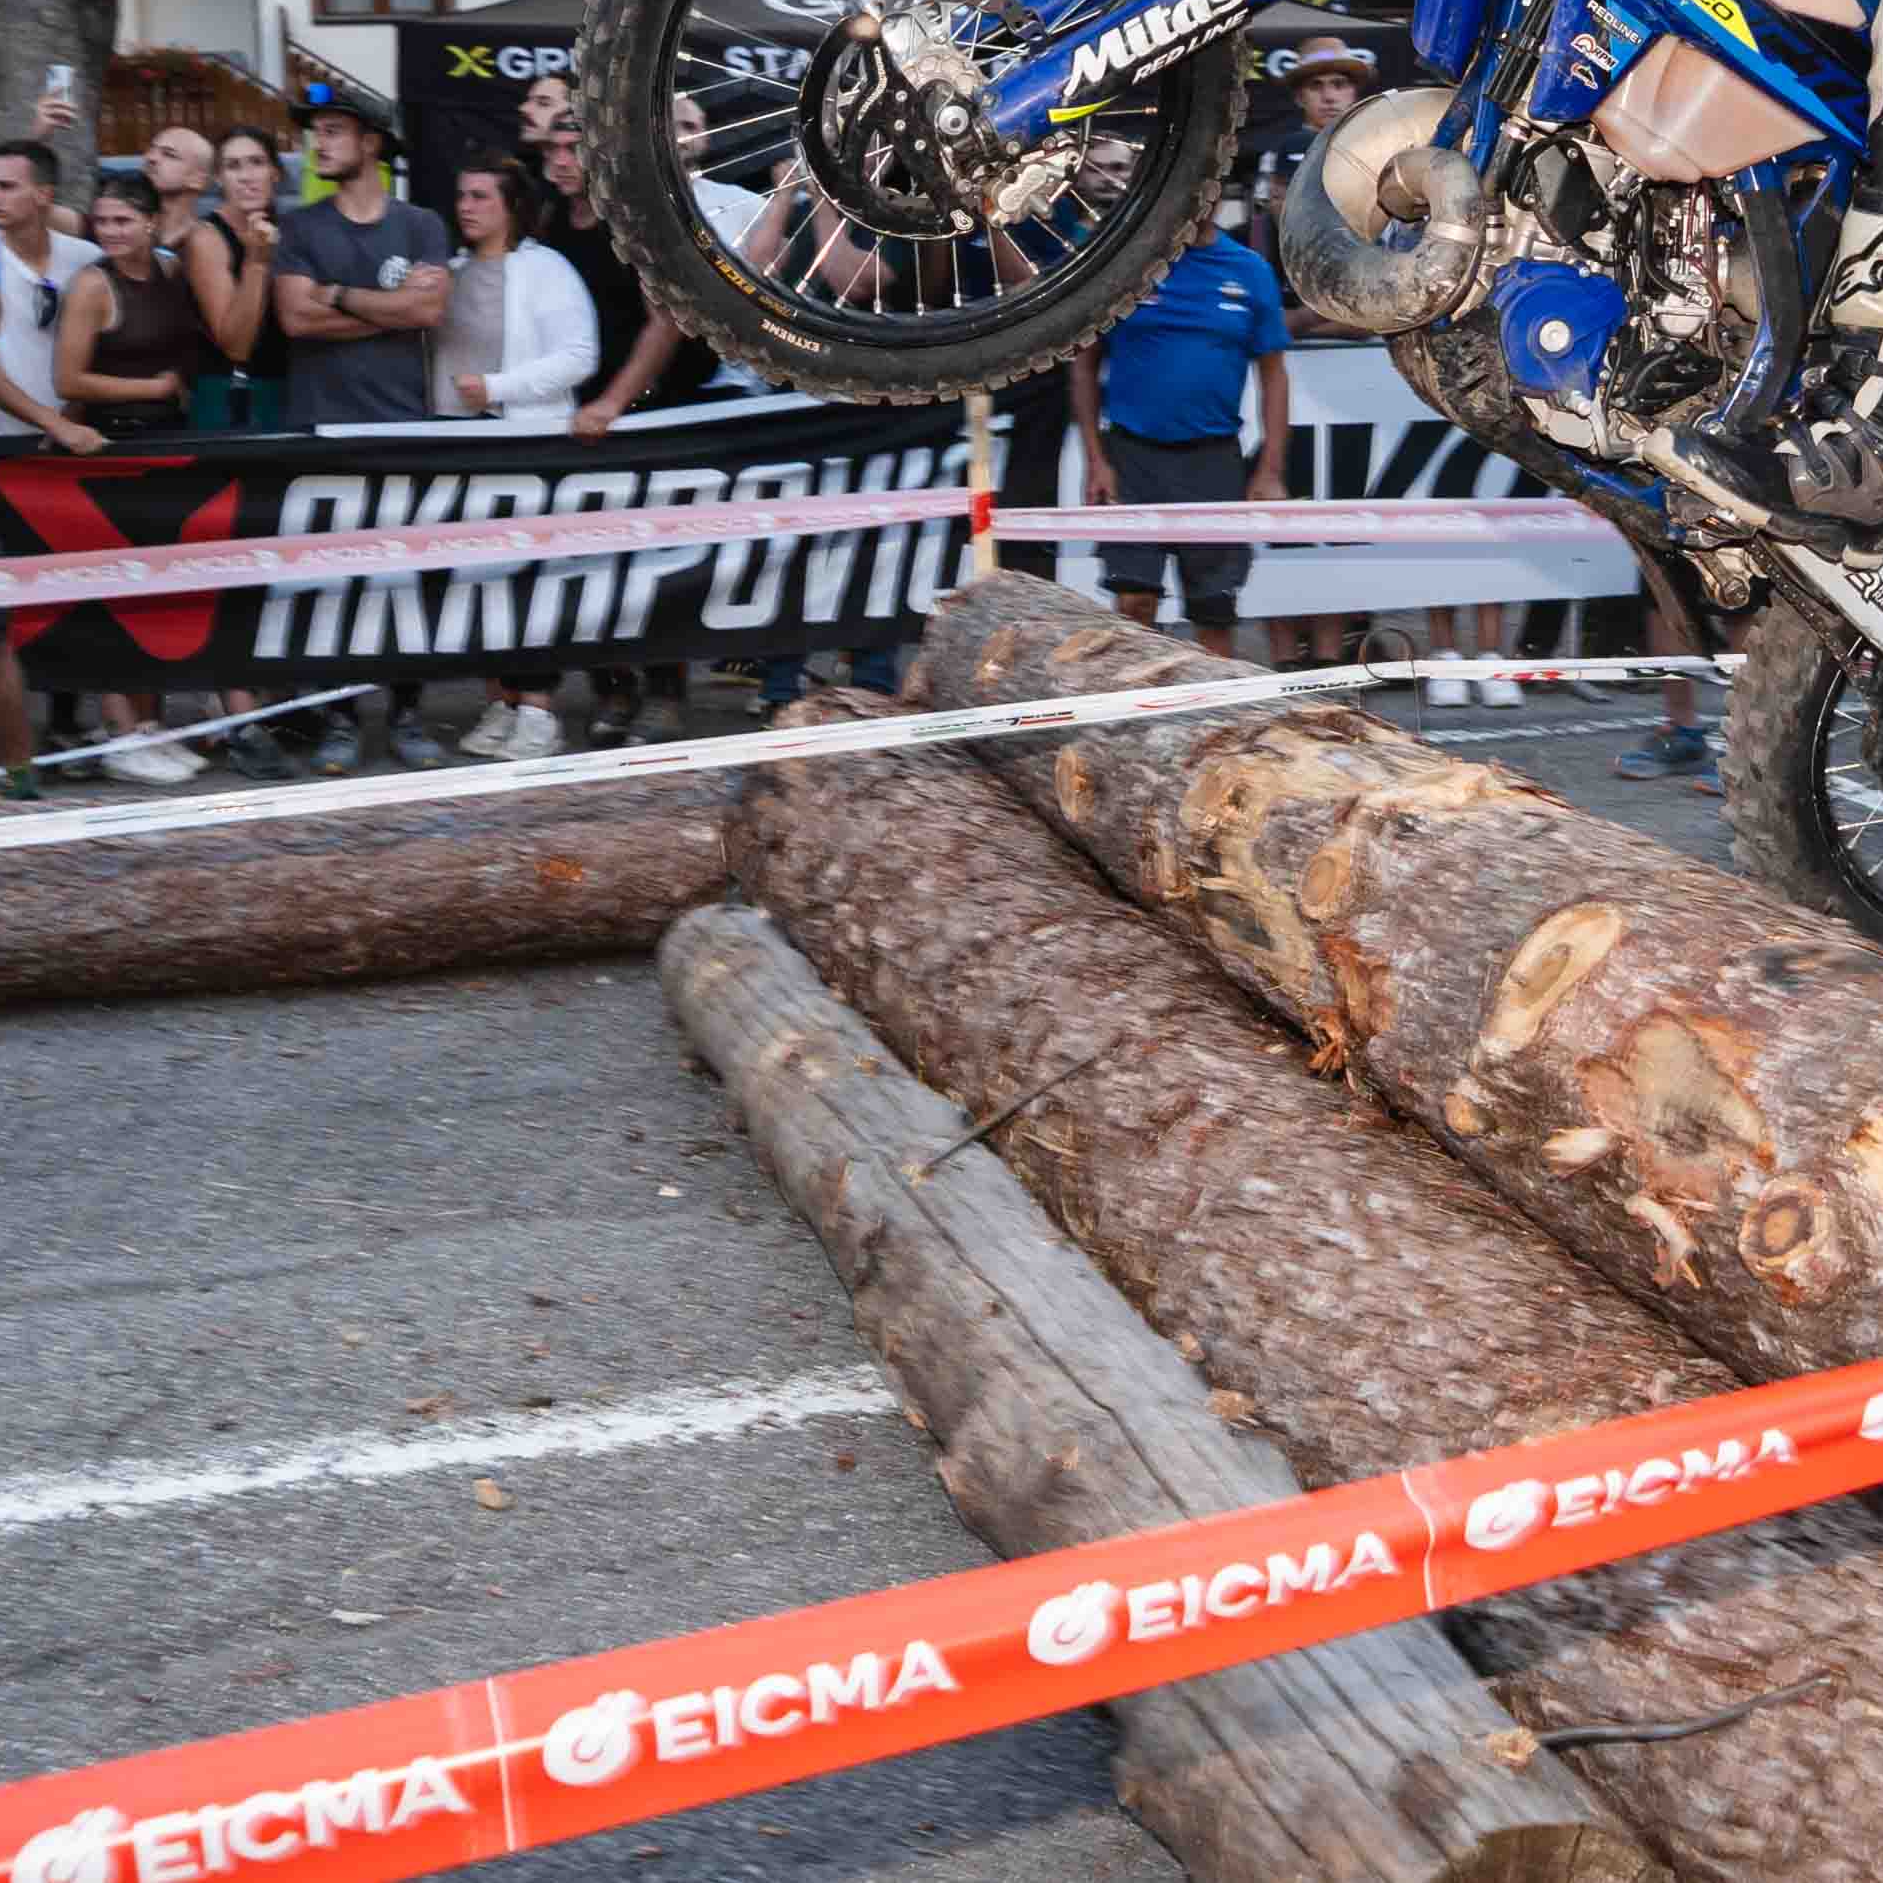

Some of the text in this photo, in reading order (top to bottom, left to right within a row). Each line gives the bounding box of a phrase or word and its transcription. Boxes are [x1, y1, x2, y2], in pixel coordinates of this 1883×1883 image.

[1131, 7, 1250, 86] RED LINE
[760, 318, 821, 354] EXTREME
[1548, 1426, 1802, 1530] EICMA
[1125, 1530, 1405, 1644] EICMA
[648, 1639, 966, 1766] EICMA
[130, 1756, 474, 1883] EICMA
